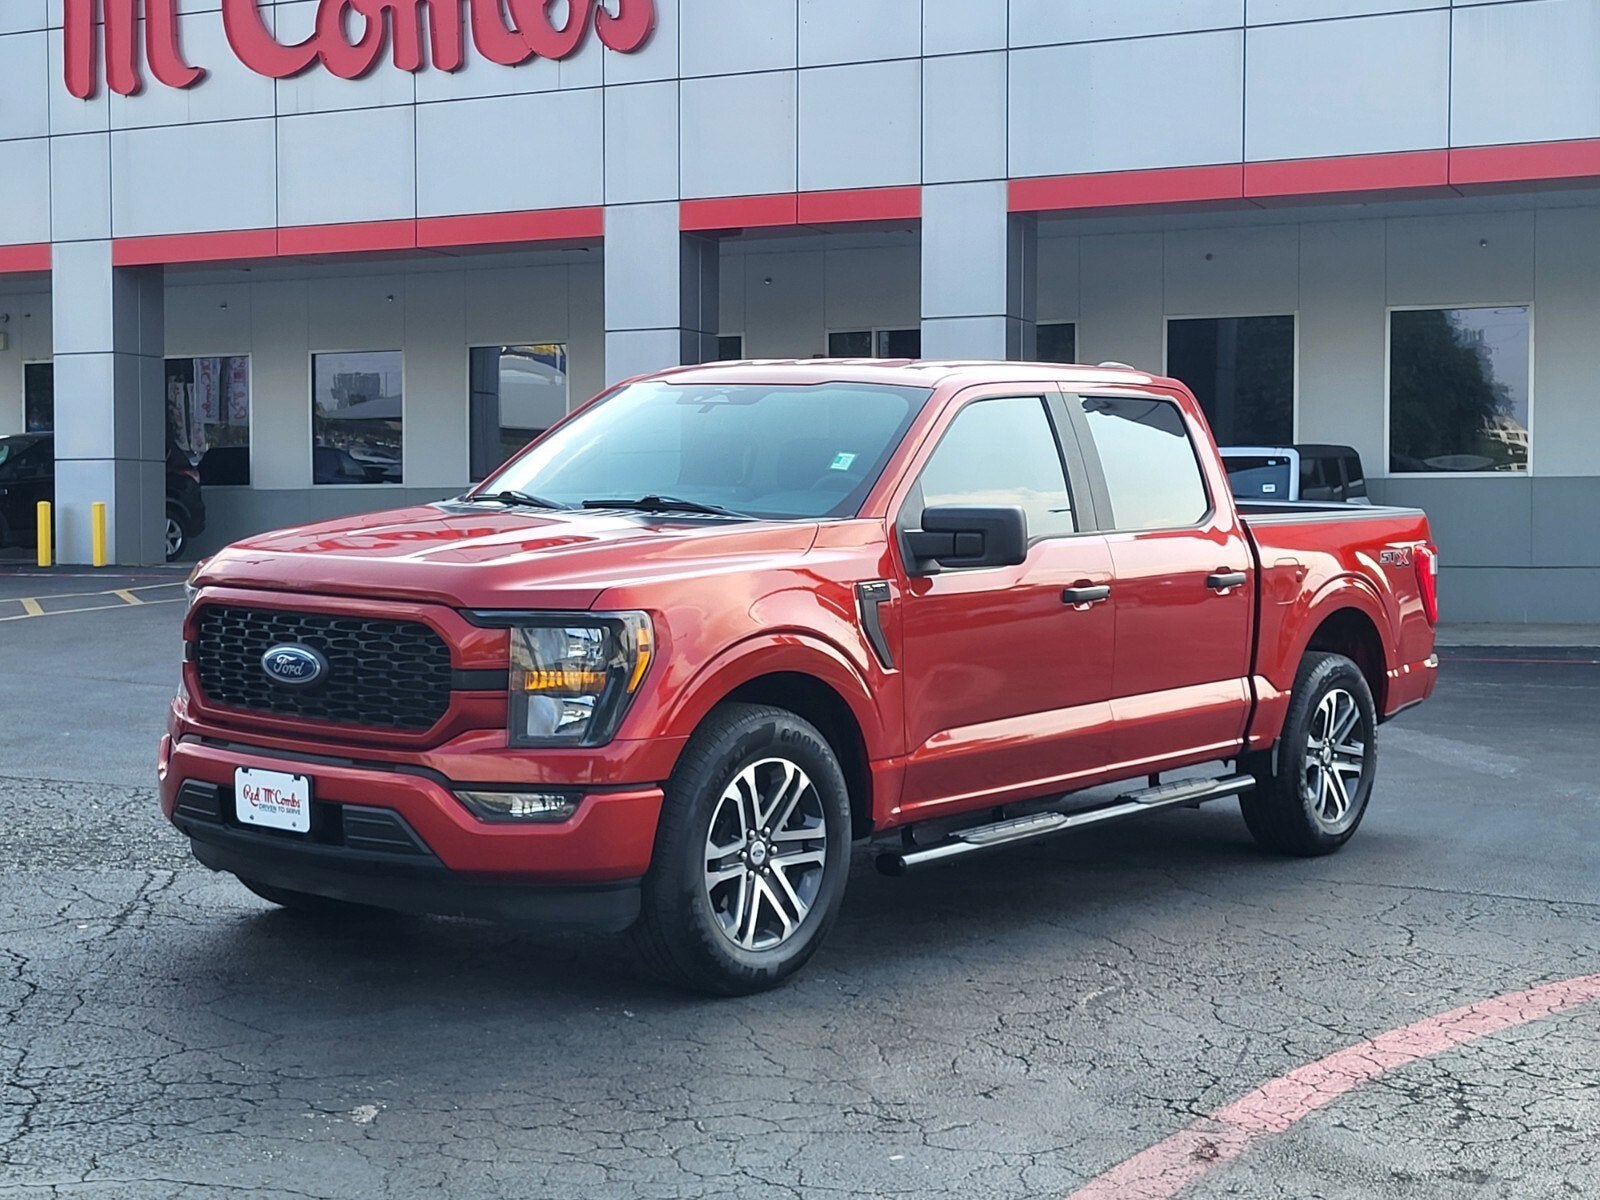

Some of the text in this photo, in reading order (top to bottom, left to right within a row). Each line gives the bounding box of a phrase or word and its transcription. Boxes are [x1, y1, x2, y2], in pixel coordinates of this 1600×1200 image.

[1380, 549, 1410, 566] STX
[273, 654, 305, 676] Ford
[243, 784, 260, 807] Red
